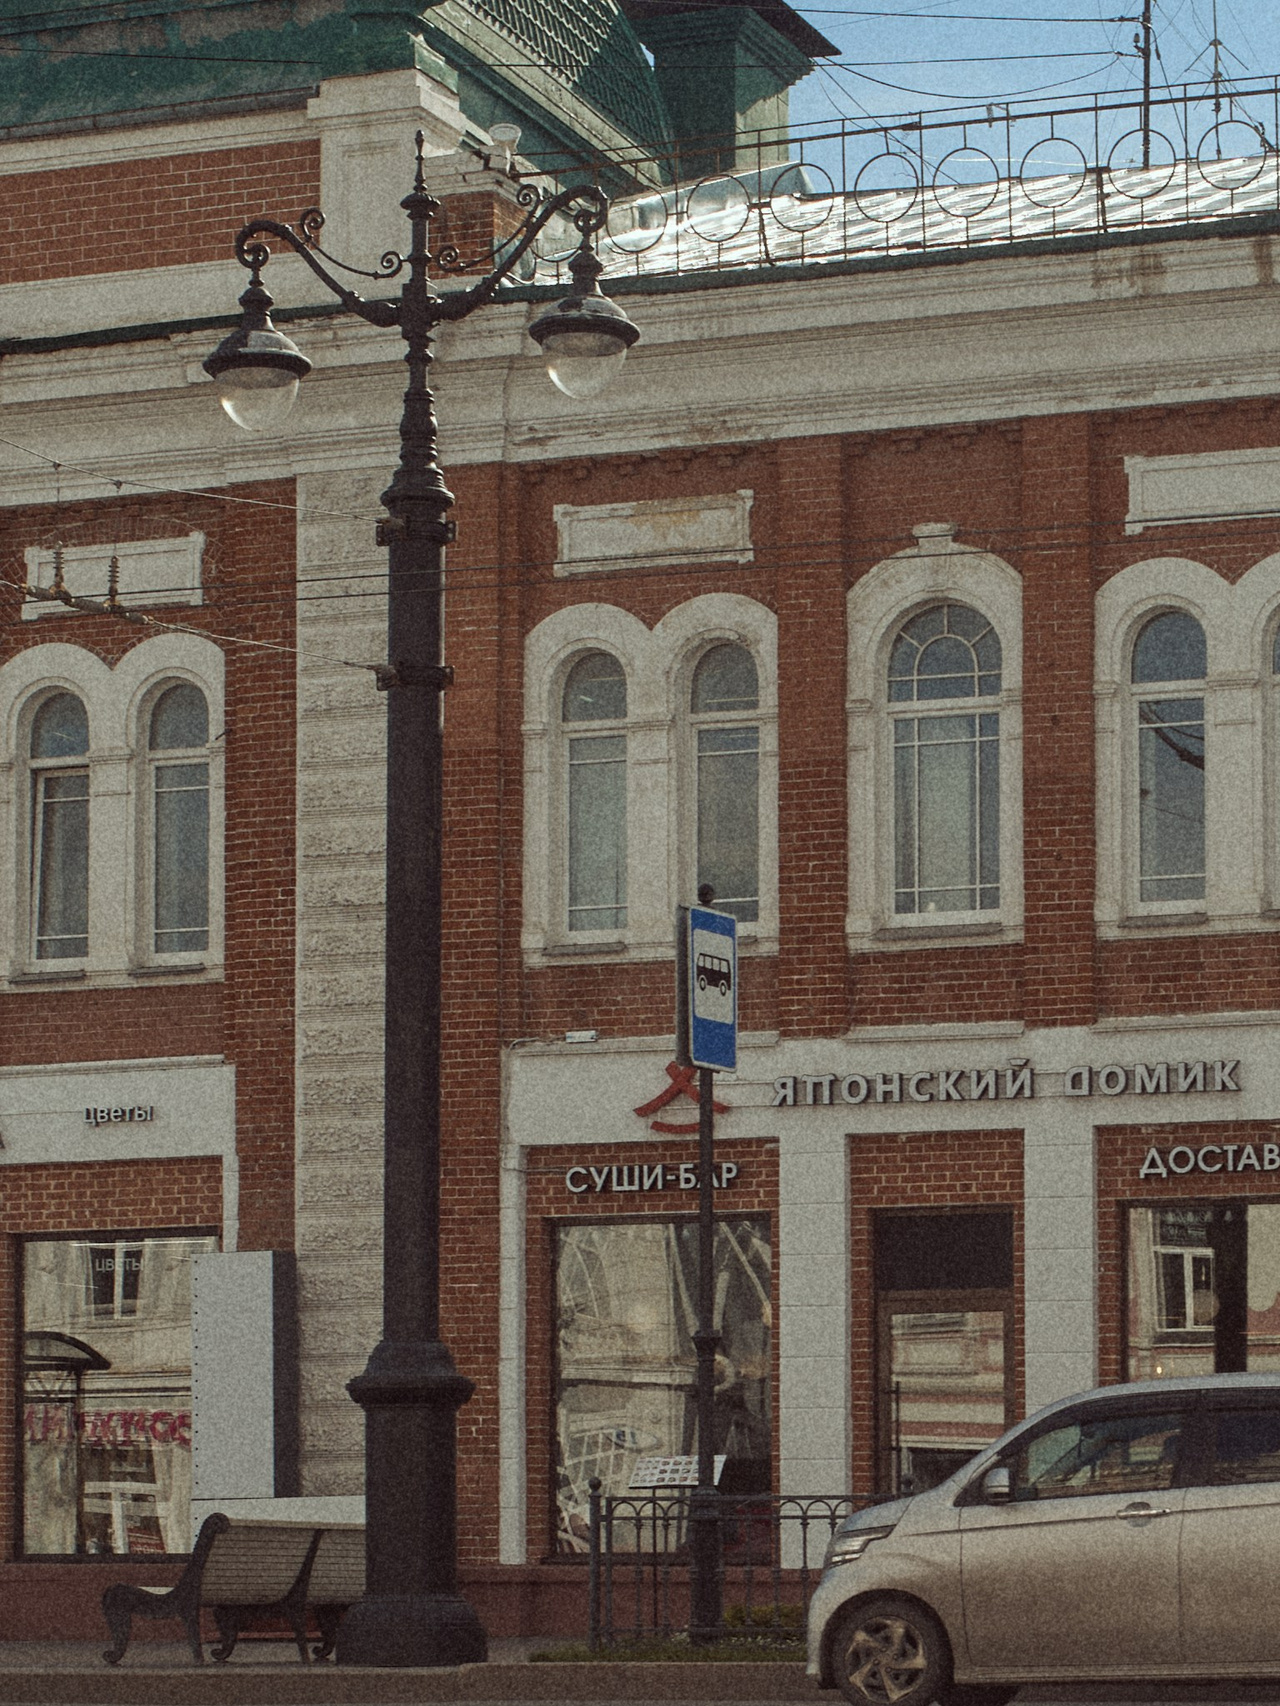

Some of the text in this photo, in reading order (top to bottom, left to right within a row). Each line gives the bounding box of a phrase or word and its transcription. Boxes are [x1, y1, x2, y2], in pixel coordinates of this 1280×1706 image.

[771, 1057, 1243, 1107] ЯПОНСКИЙ ДОМИК
[83, 1105, 154, 1127] цветы
